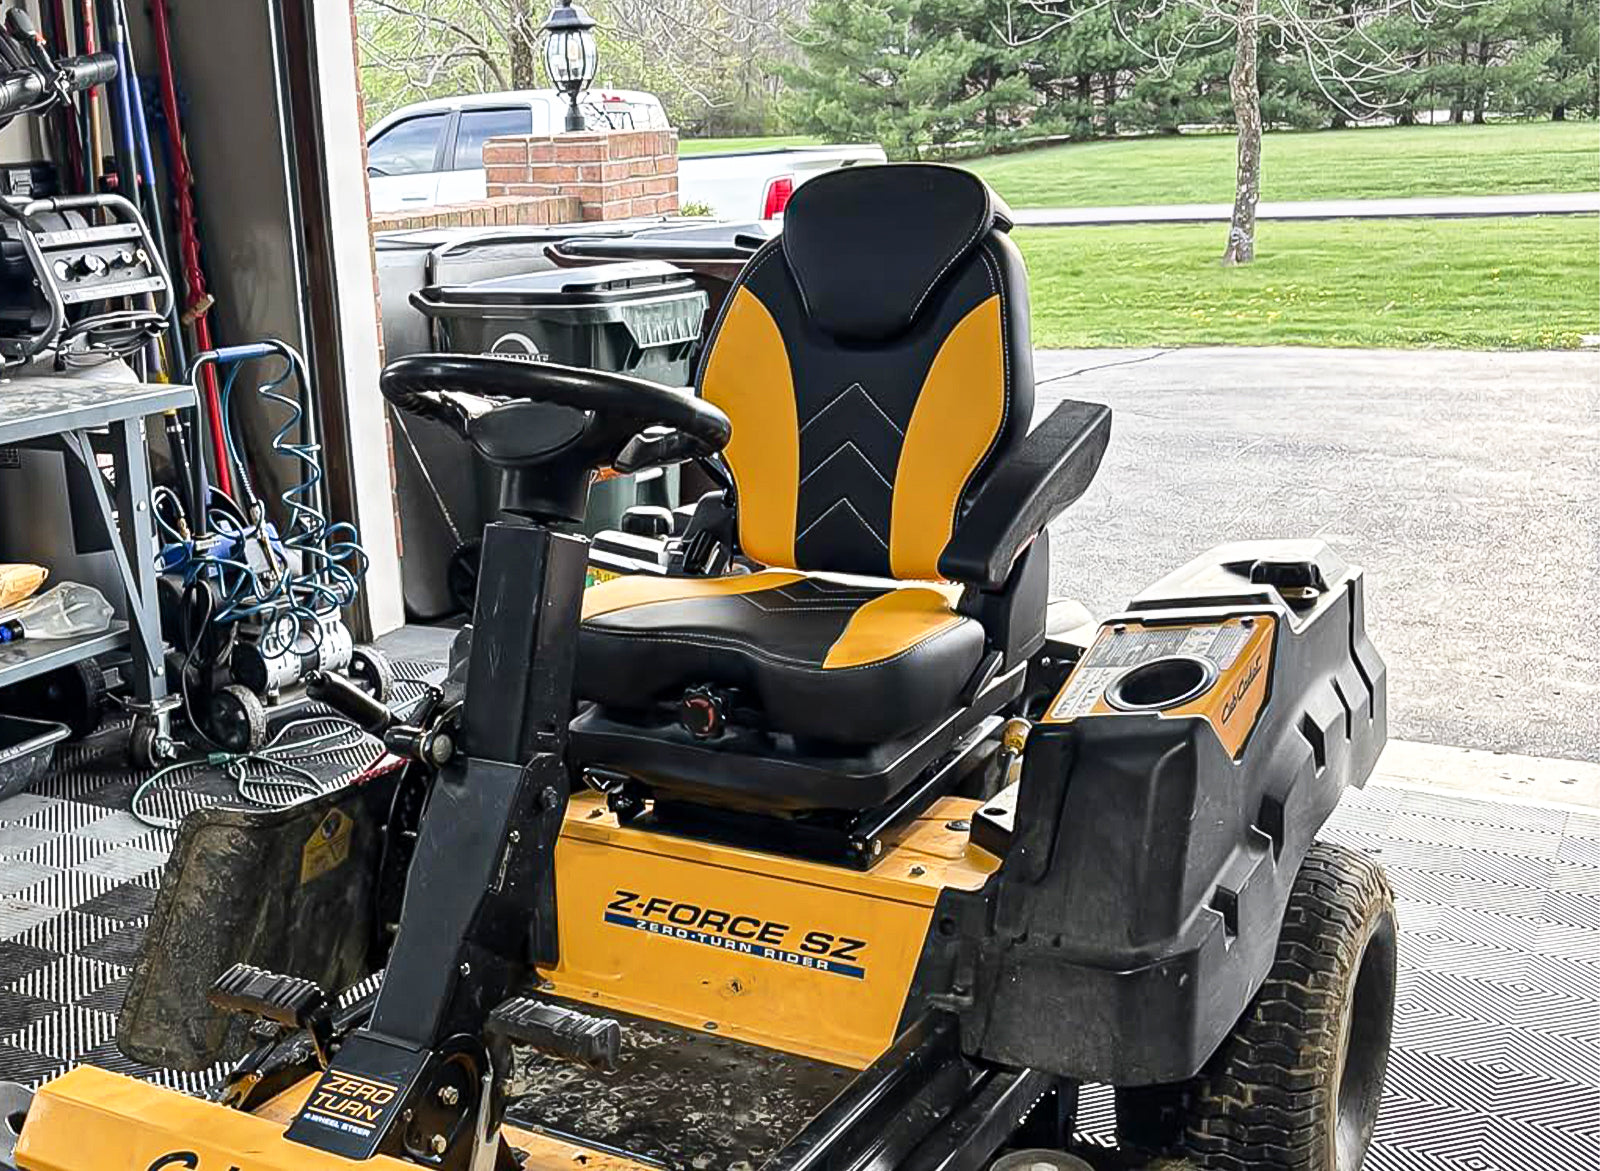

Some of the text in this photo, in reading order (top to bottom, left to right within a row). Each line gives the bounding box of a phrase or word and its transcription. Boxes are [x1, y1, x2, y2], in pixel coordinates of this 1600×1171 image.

[608, 890, 867, 962] Z-FORCE SZ
[763, 947, 830, 970] RIDER
[322, 1075, 395, 1104] ZERO
[313, 1091, 383, 1121] TURN
[310, 1114, 340, 1129] WHEEL
[340, 1122, 371, 1137] STEER
